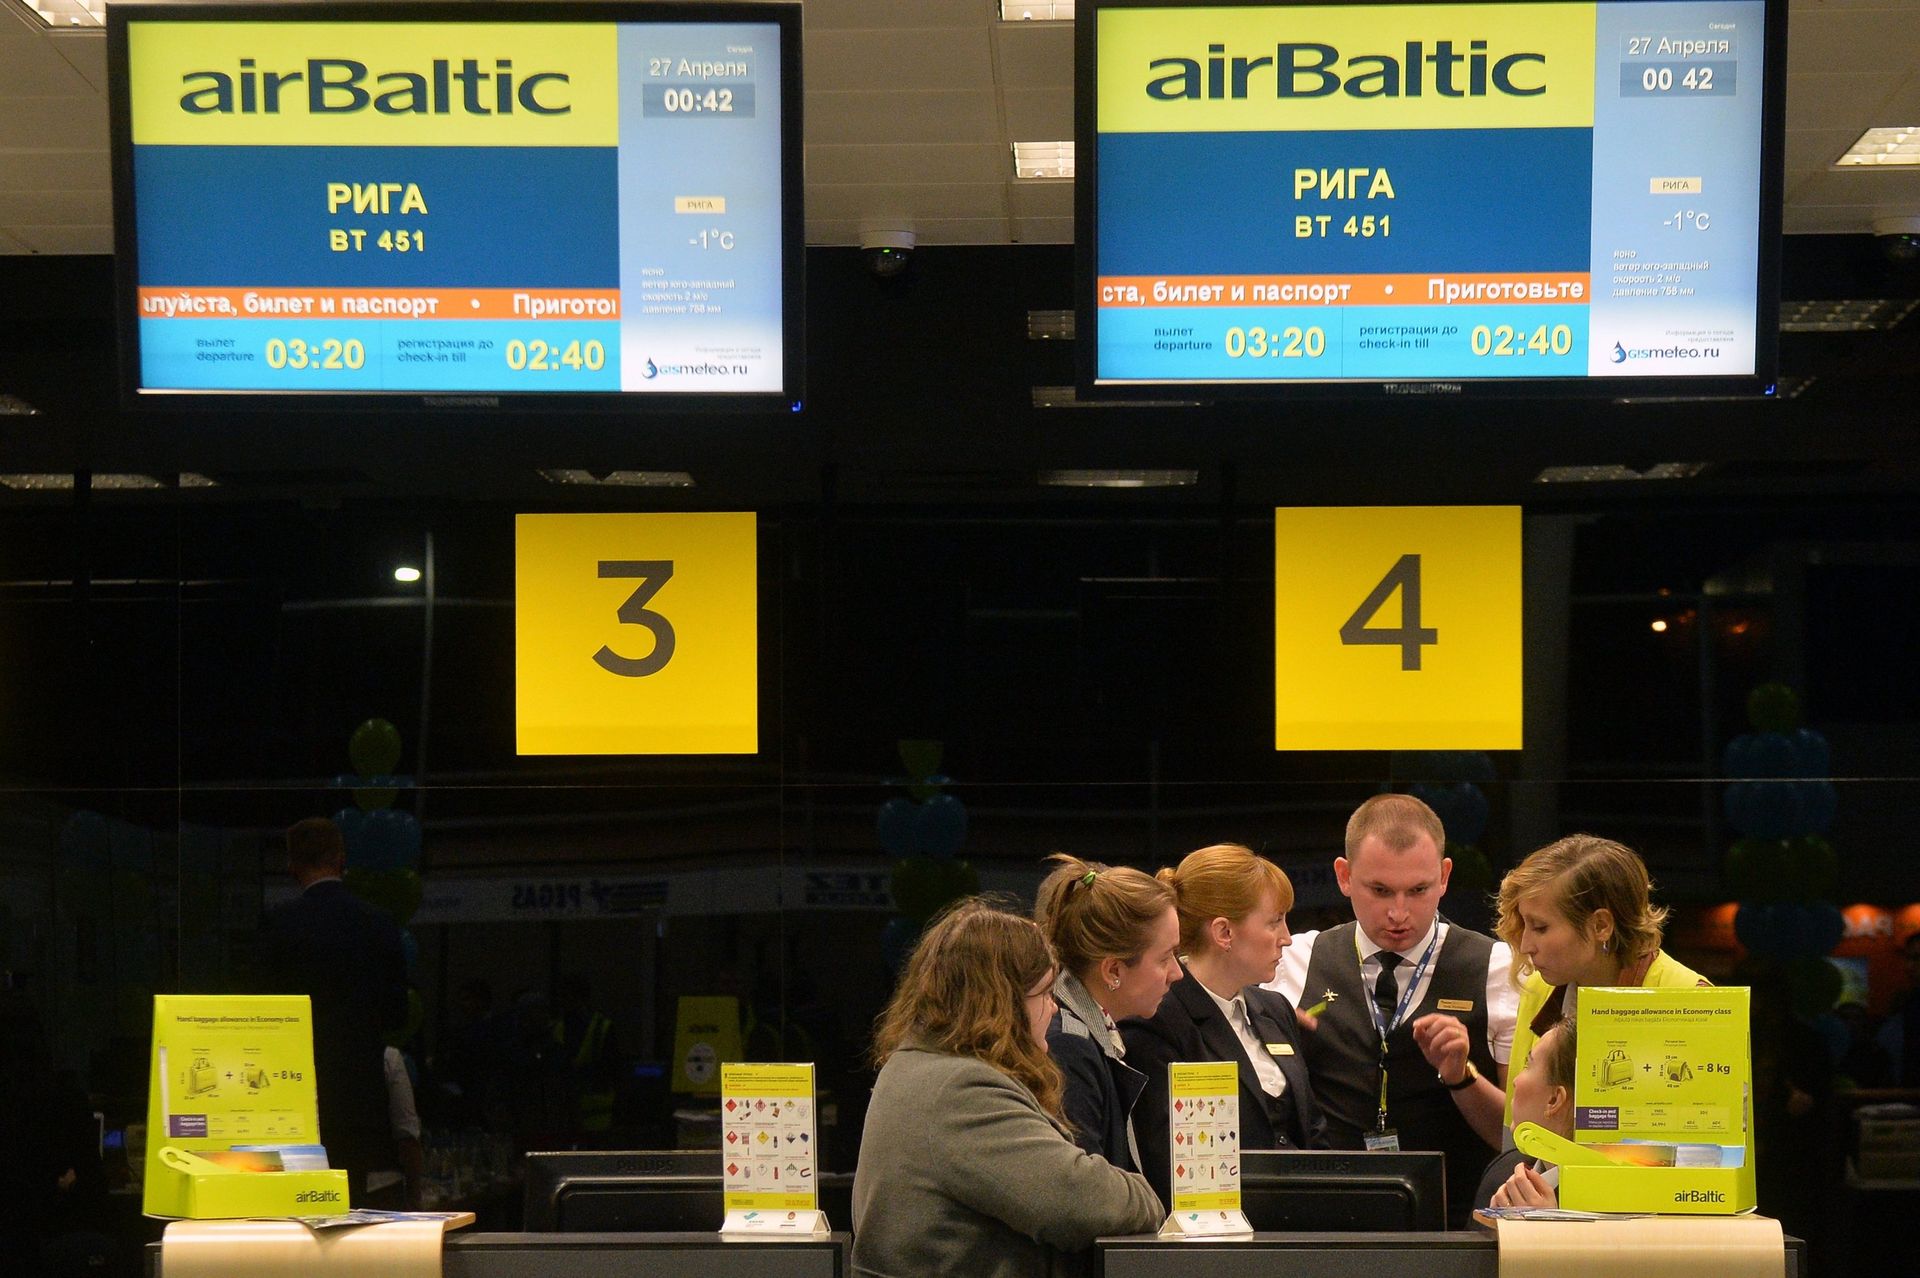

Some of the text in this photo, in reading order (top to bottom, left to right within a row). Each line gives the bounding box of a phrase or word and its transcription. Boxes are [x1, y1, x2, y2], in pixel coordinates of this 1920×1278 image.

[1629, 37, 1729, 58] 27 Апреля
[650, 58, 748, 79] 27 Апреля
[1146, 40, 1547, 100] airBaltic
[1642, 67, 1713, 91] 00 42
[180, 58, 572, 117] airBaltic
[664, 88, 733, 112] 00:42
[1294, 168, 1395, 200] РИГА
[1662, 181, 1690, 191] РИГА
[327, 183, 428, 216] РИГА
[1343, 215, 1392, 238] 451
[377, 230, 426, 252] 451
[1657, 274, 1663, 284] 2
[1153, 281, 1224, 302] билет
[1231, 284, 1245, 301] и
[1253, 283, 1351, 305] паспорт
[1428, 279, 1584, 303] Приготовьте
[243, 292, 315, 314] билет
[320, 297, 335, 313] и
[342, 296, 440, 319] паспорт
[1154, 328, 1193, 337] вылет
[1359, 325, 1458, 336] регистрация до
[1471, 324, 1573, 356] 02:40
[196, 338, 235, 348] вылет
[398, 339, 494, 351] регистрация до
[1154, 340, 1212, 352] departure
[1225, 326, 1326, 358] 03:20
[1359, 338, 1429, 349] check-in till
[196, 351, 254, 362] departure
[265, 338, 366, 370] 03:20
[397, 351, 466, 362] check-in till
[505, 339, 606, 371] 02:40
[591, 559, 677, 678] 3
[1339, 554, 1439, 671] 4
[1610, 1008, 1639, 1017] baggage
[1683, 1008, 1713, 1016] Economy
[281, 1070, 288, 1080] 8
[290, 1070, 303, 1082] kg
[1706, 1063, 1714, 1073] 8
[1716, 1063, 1731, 1075] kg
[296, 1190, 340, 1203] airBaltic
[1675, 1190, 1726, 1203] airBaltic
